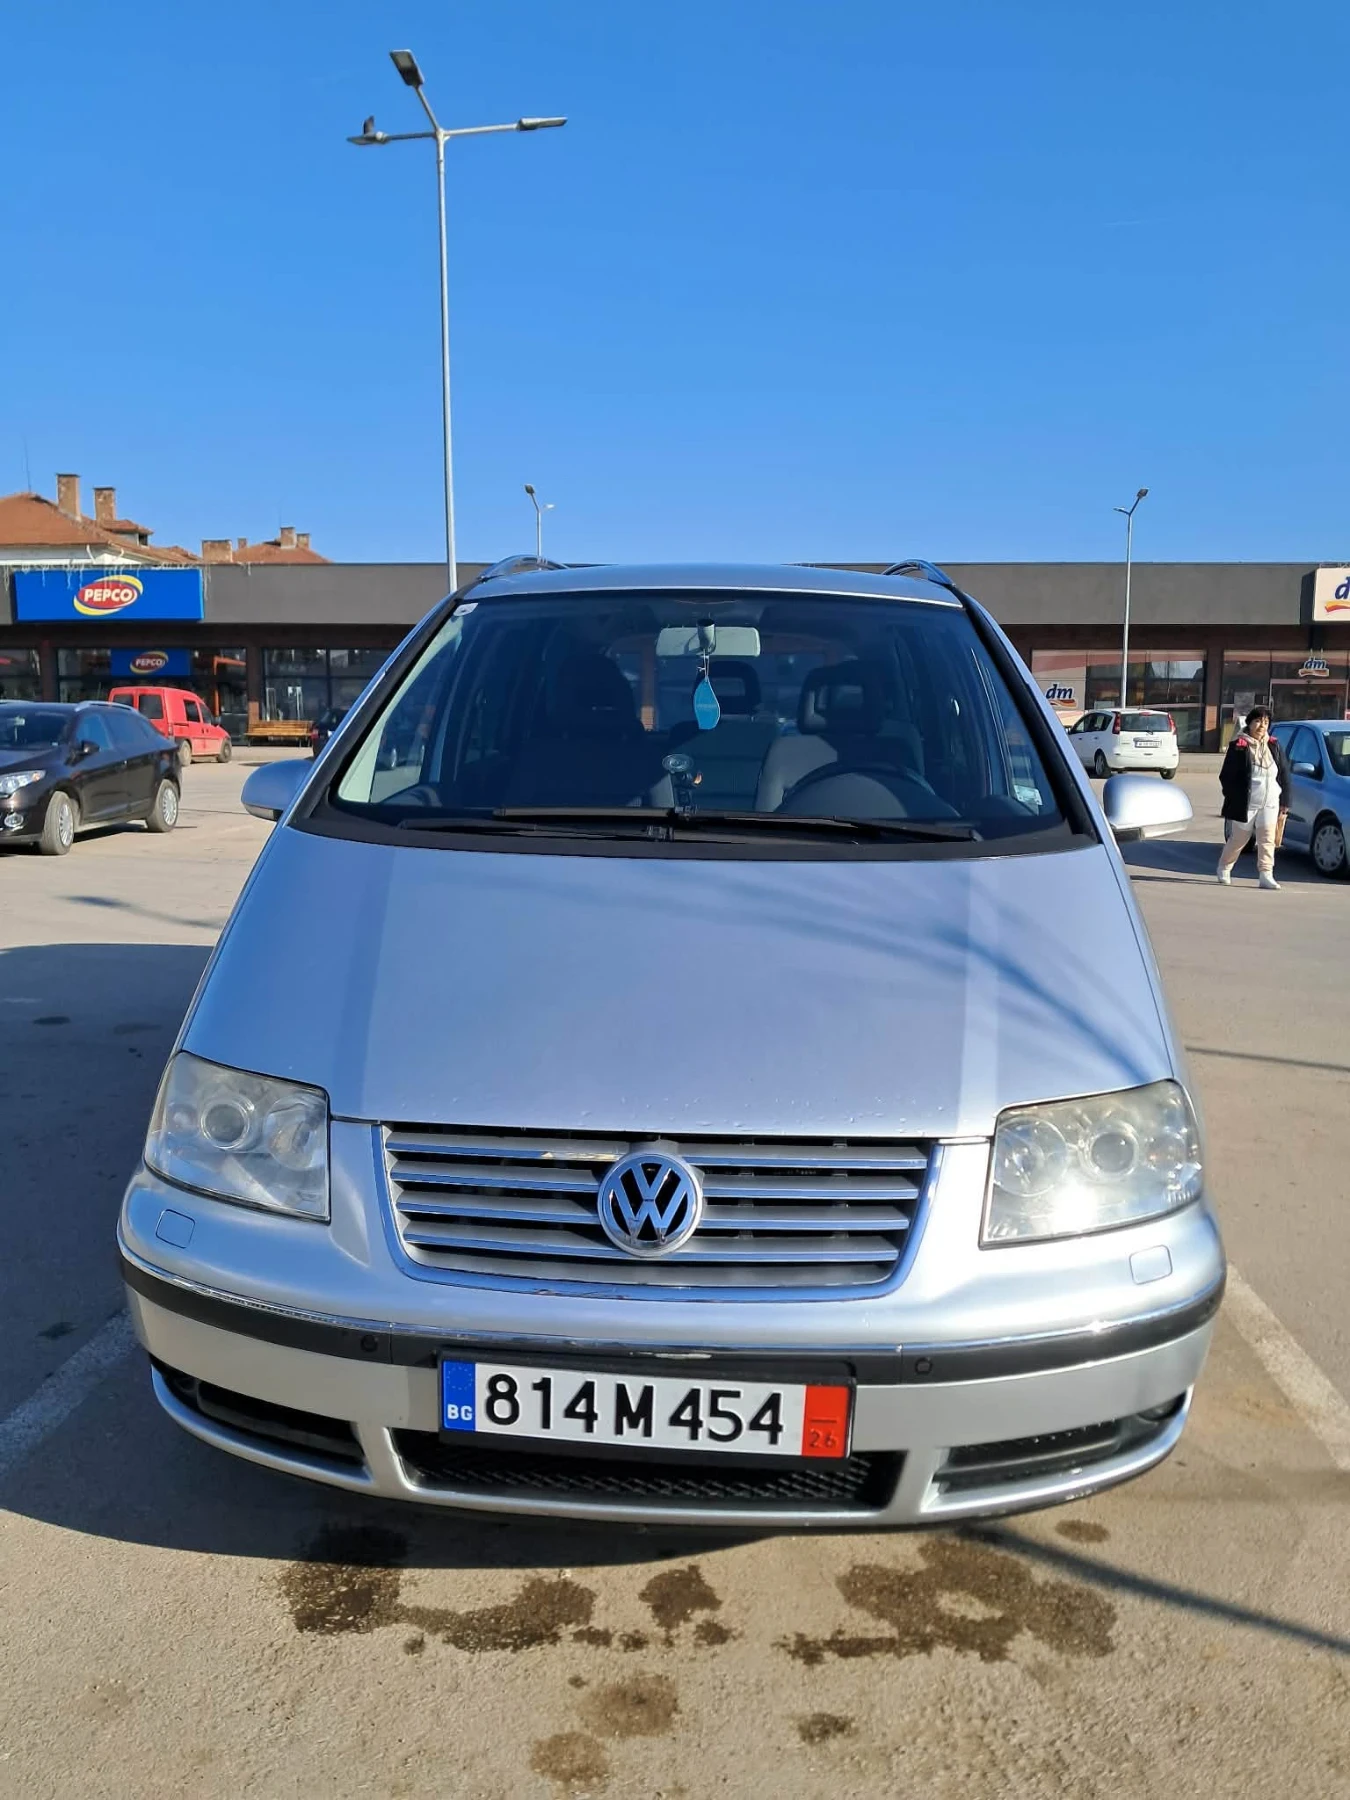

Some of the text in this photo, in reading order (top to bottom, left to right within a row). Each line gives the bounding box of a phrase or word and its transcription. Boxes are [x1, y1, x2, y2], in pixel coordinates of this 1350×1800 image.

[84, 588, 133, 602] PEPCO
[1335, 576, 1350, 600] d
[135, 658, 164, 667] PEPCO
[1304, 658, 1325, 669] dm
[1045, 683, 1073, 699] dm
[604, 1158, 698, 1250] VW
[447, 1404, 473, 1421] BG
[808, 1428, 838, 1448] 26
